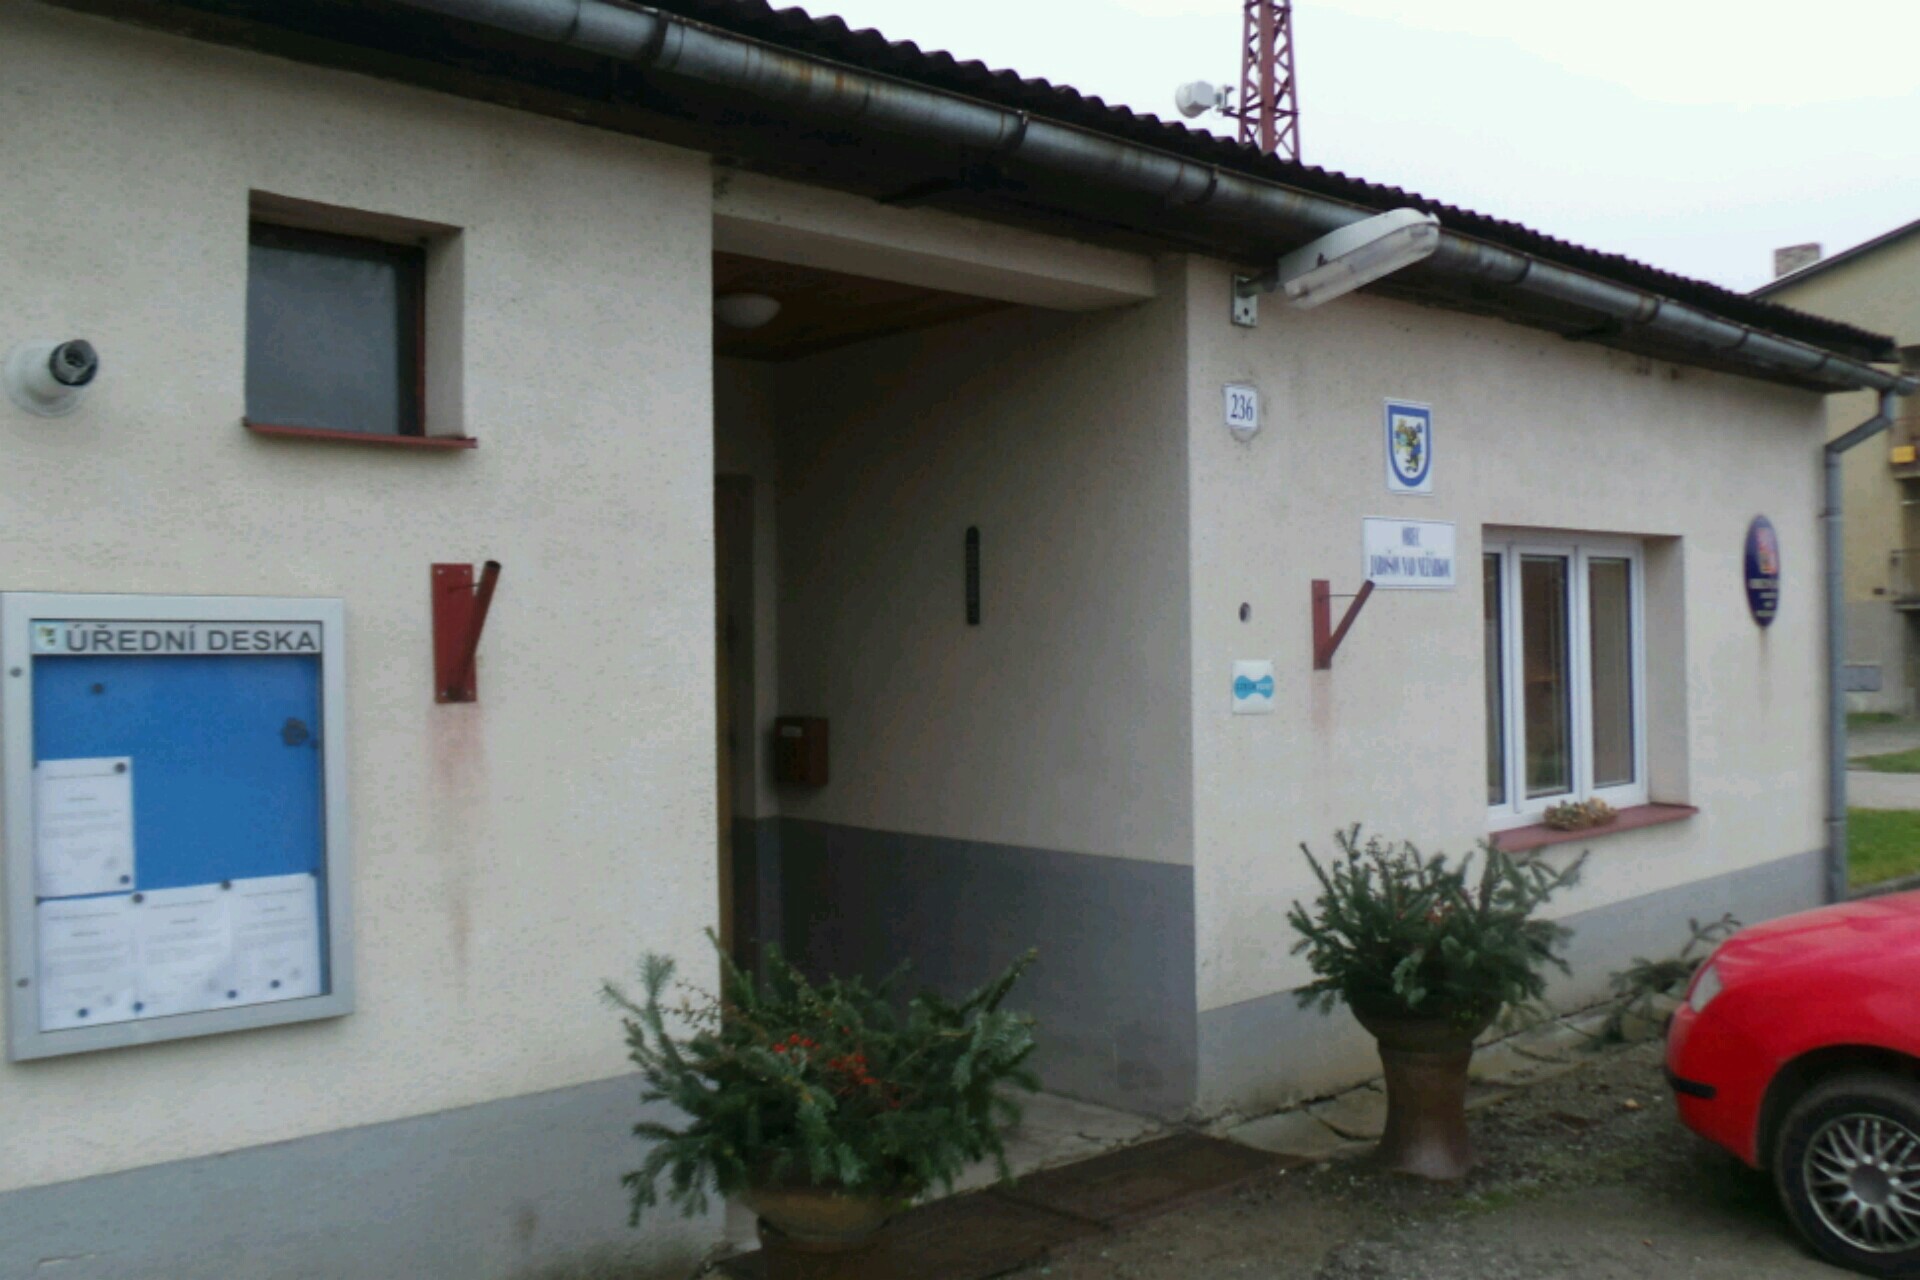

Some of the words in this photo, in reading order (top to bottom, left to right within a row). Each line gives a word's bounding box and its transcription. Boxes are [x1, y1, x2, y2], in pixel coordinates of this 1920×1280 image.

[1230, 393, 1254, 422] 236
[65, 624, 196, 652] ÚŘEDNÍ
[206, 629, 317, 651] DESKA
